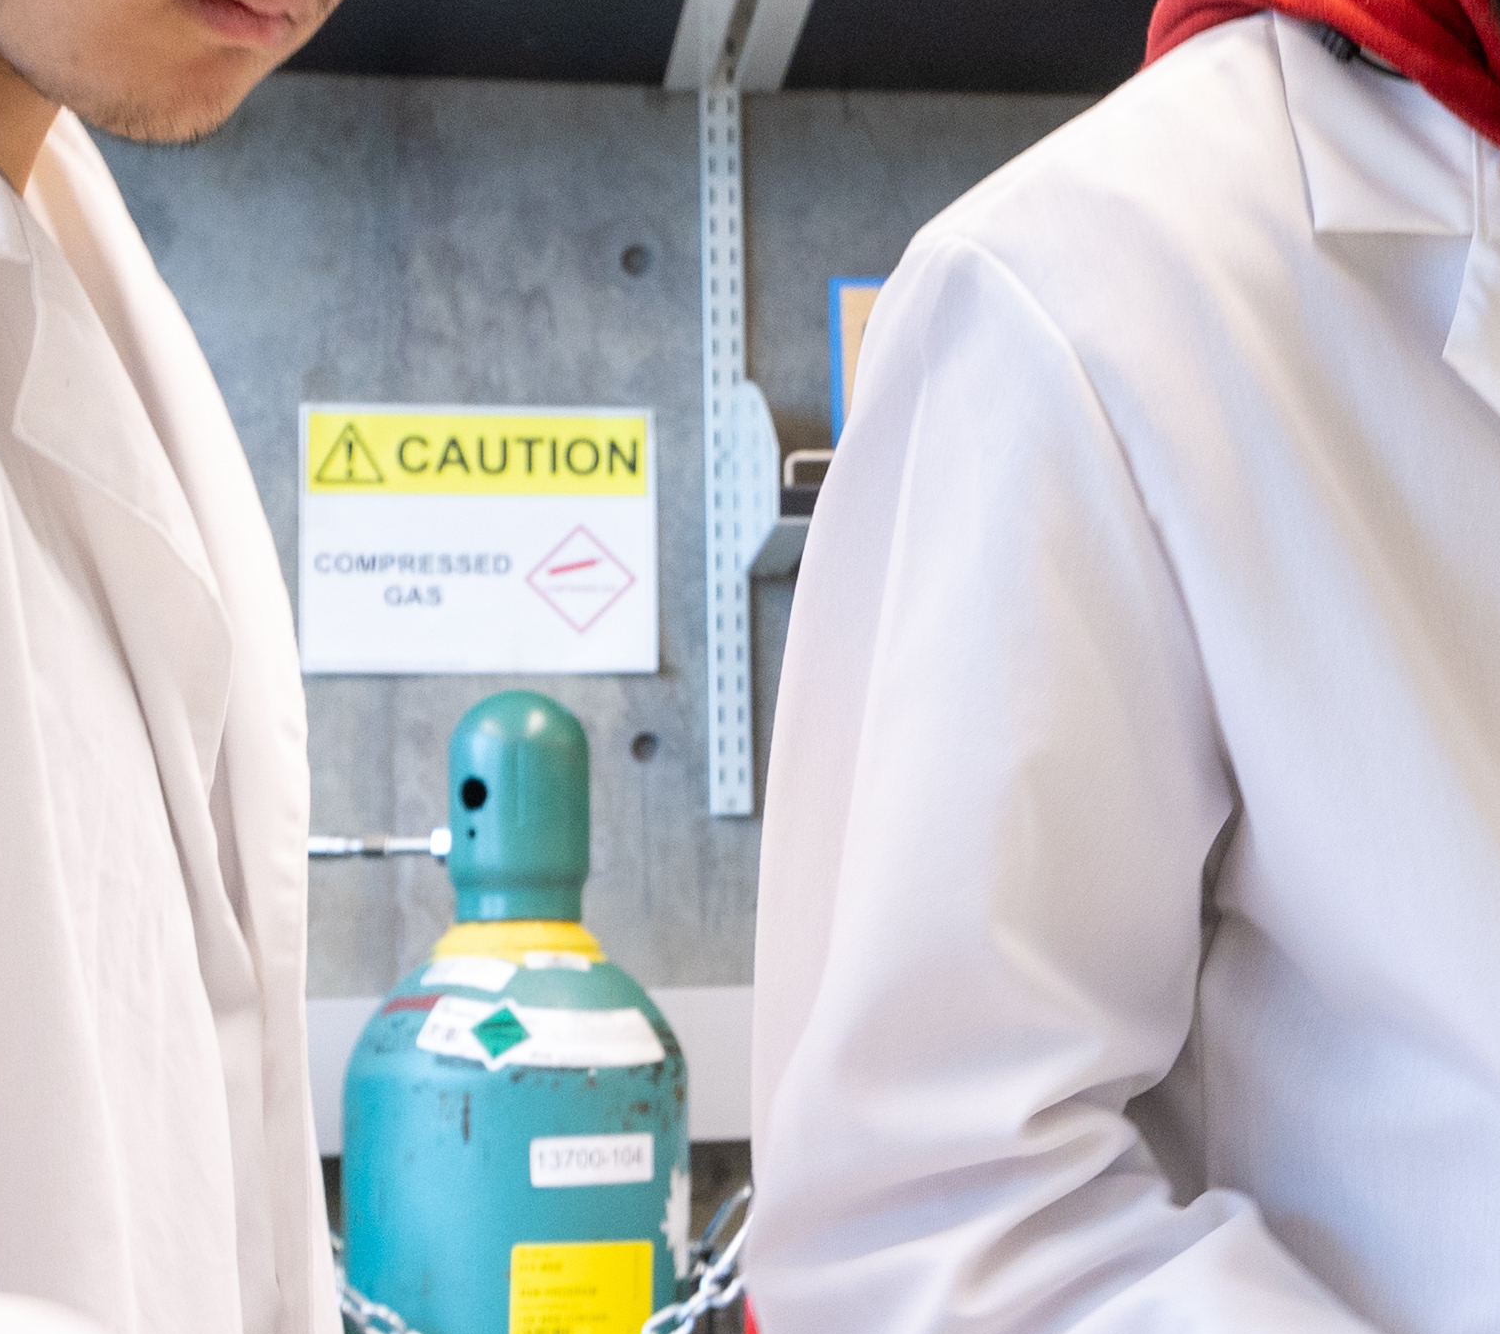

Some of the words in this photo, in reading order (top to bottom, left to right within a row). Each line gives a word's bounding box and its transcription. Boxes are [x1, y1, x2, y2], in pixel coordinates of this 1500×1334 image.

[397, 433, 639, 476] CAUTION
[313, 551, 512, 575] COMPRESSED
[383, 584, 444, 607] GAS
